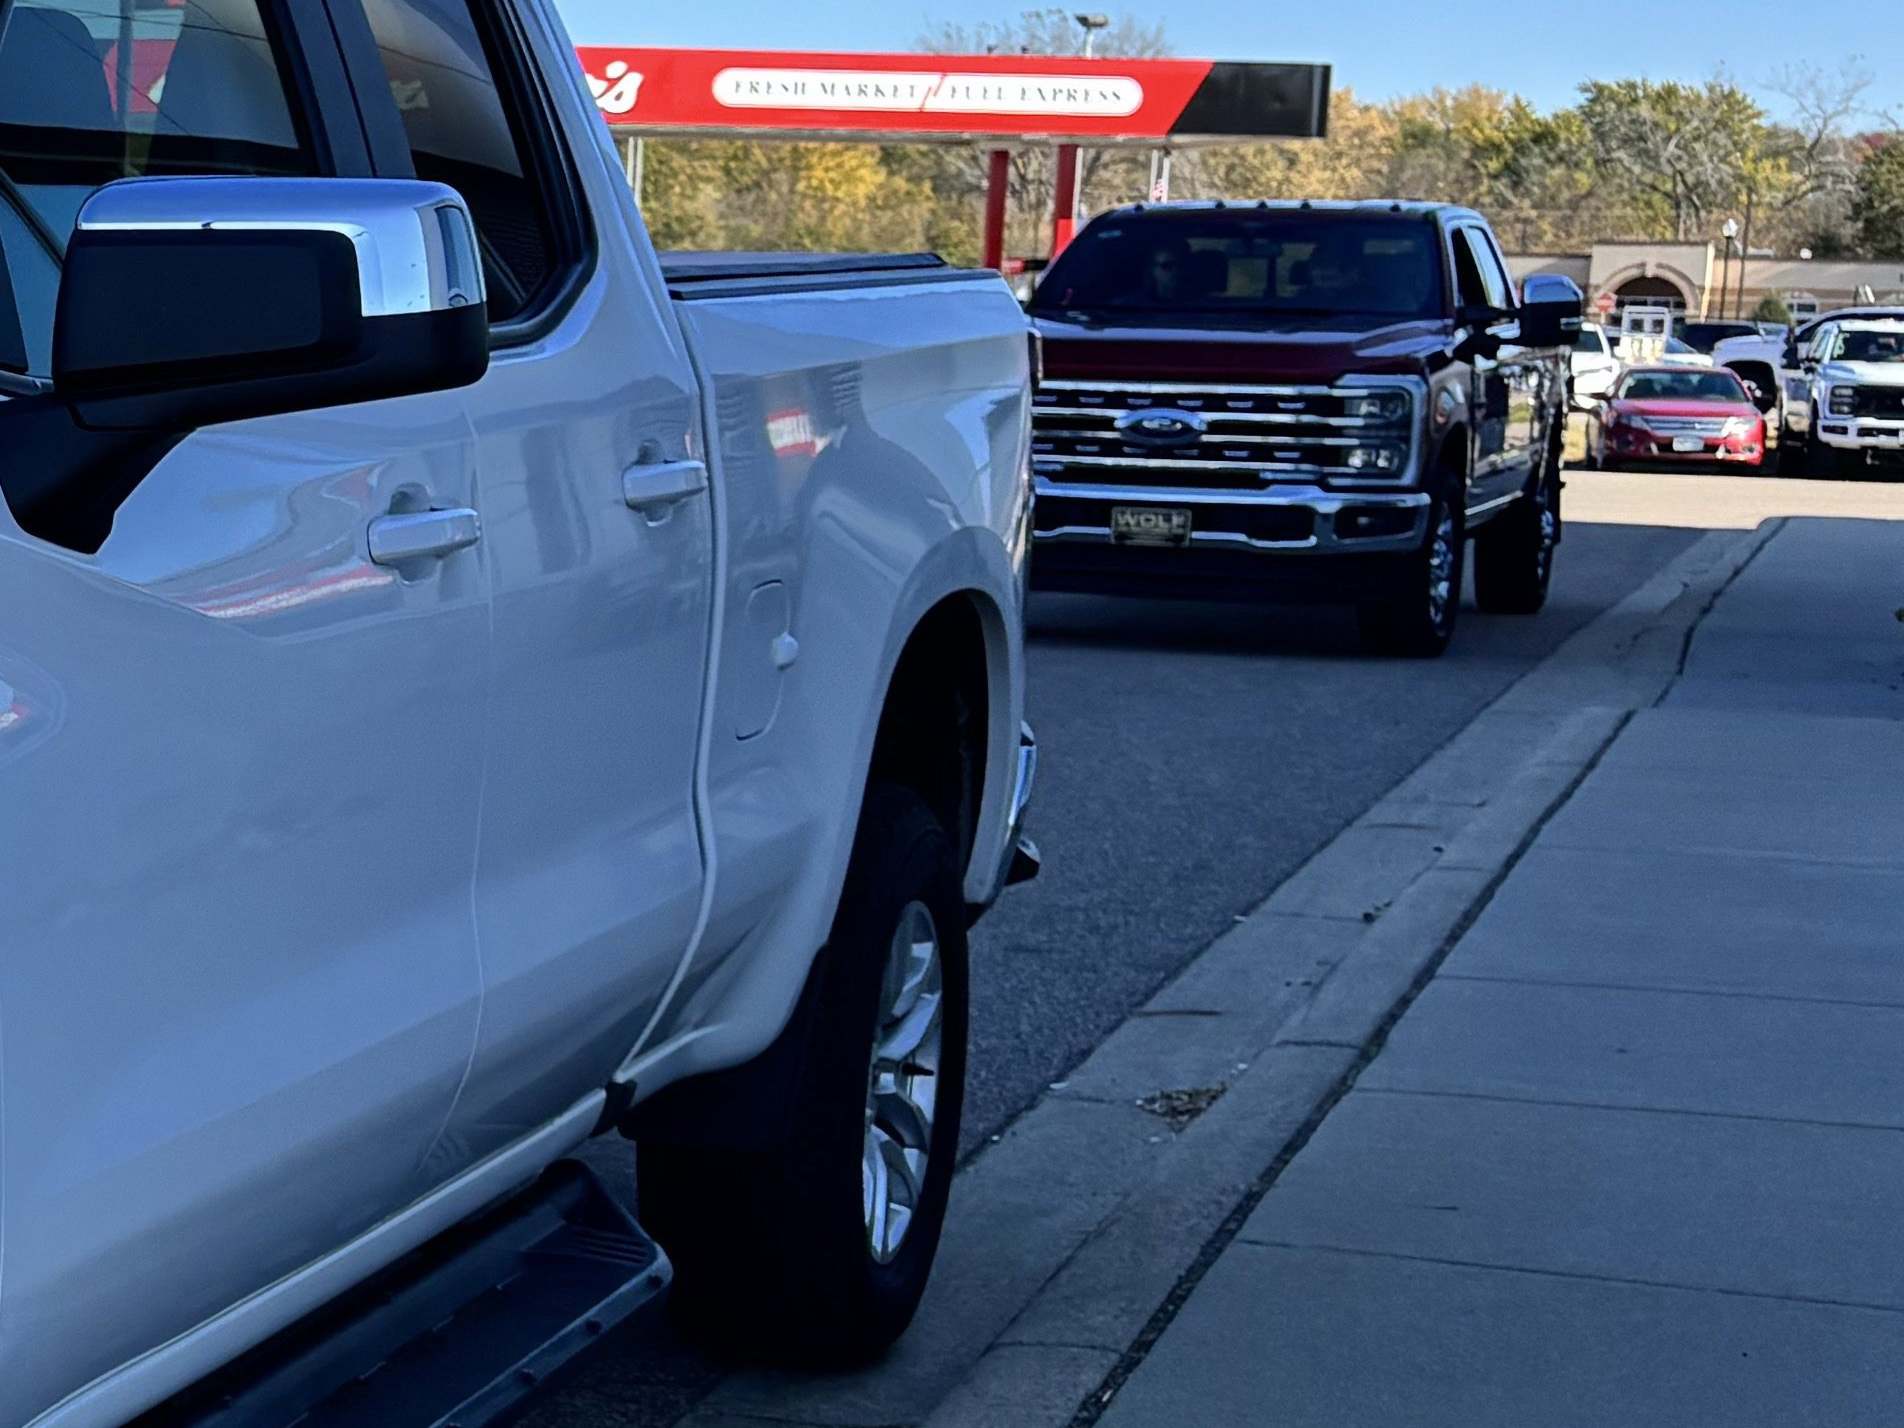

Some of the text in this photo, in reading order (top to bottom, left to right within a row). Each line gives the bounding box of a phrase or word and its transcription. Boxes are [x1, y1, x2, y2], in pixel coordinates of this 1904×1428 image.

[734, 80, 807, 95] FRESH
[820, 82, 915, 98] MARKET
[1020, 86, 1122, 102] EXPRESS
[1116, 513, 1184, 528] WOLF
